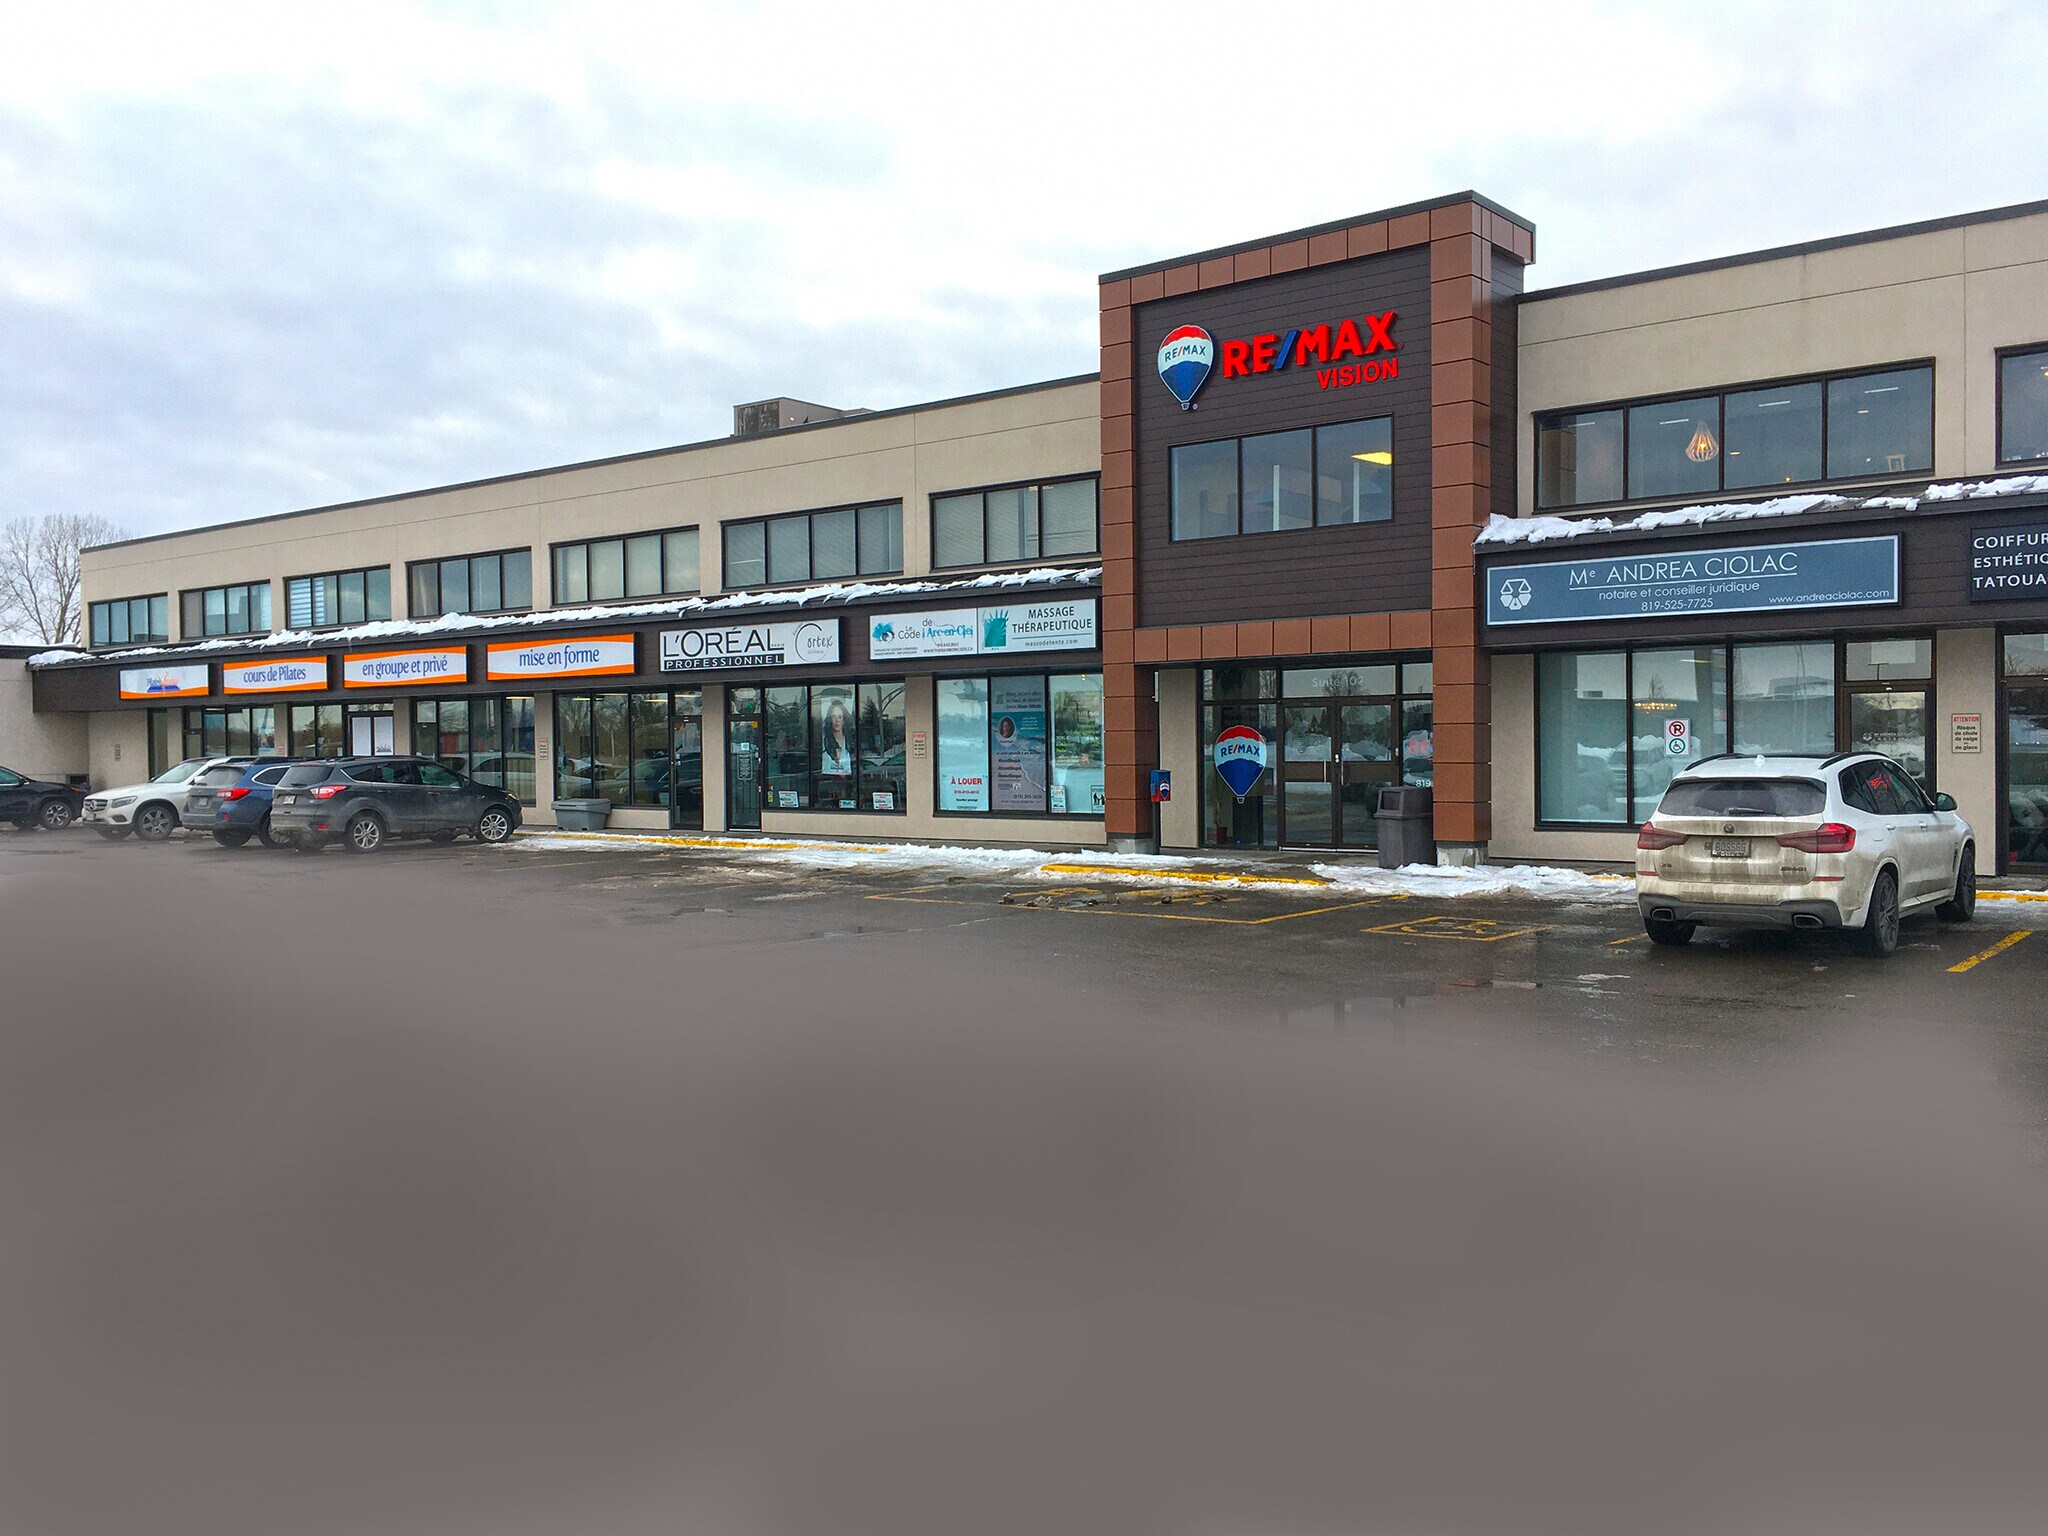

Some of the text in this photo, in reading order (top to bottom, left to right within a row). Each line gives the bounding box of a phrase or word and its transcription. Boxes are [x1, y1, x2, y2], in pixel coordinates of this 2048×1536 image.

[1223, 311, 1398, 378] RE/MAX
[1164, 345, 1206, 363] RE/MAX
[1316, 357, 1399, 389] VISION
[1606, 560, 1697, 583] ANDREA
[1704, 552, 1798, 576] CIOLAC
[1972, 573, 2047, 589] TATOUA
[1599, 581, 1760, 600] notaire et conseiller juridique
[1768, 589, 1890, 604] www.andreaciolac.com
[1028, 606, 1075, 619] MASSAGE
[1641, 597, 1714, 612] 819-525-7725
[922, 618, 933, 627] de
[1012, 618, 1092, 634] THÉRAPEUTIQUE
[664, 627, 785, 658] L'ORÉAL
[898, 630, 921, 640] Code
[1025, 639, 1079, 647] massodetente.com
[519, 645, 600, 667] mise en forme
[666, 655, 782, 669] PROFESSIONNEL
[243, 665, 306, 683] cours de Pilates
[362, 655, 448, 679] en groupe et privé
[1220, 744, 1260, 757] RE/MAX
[951, 775, 983, 785] À LOUER
